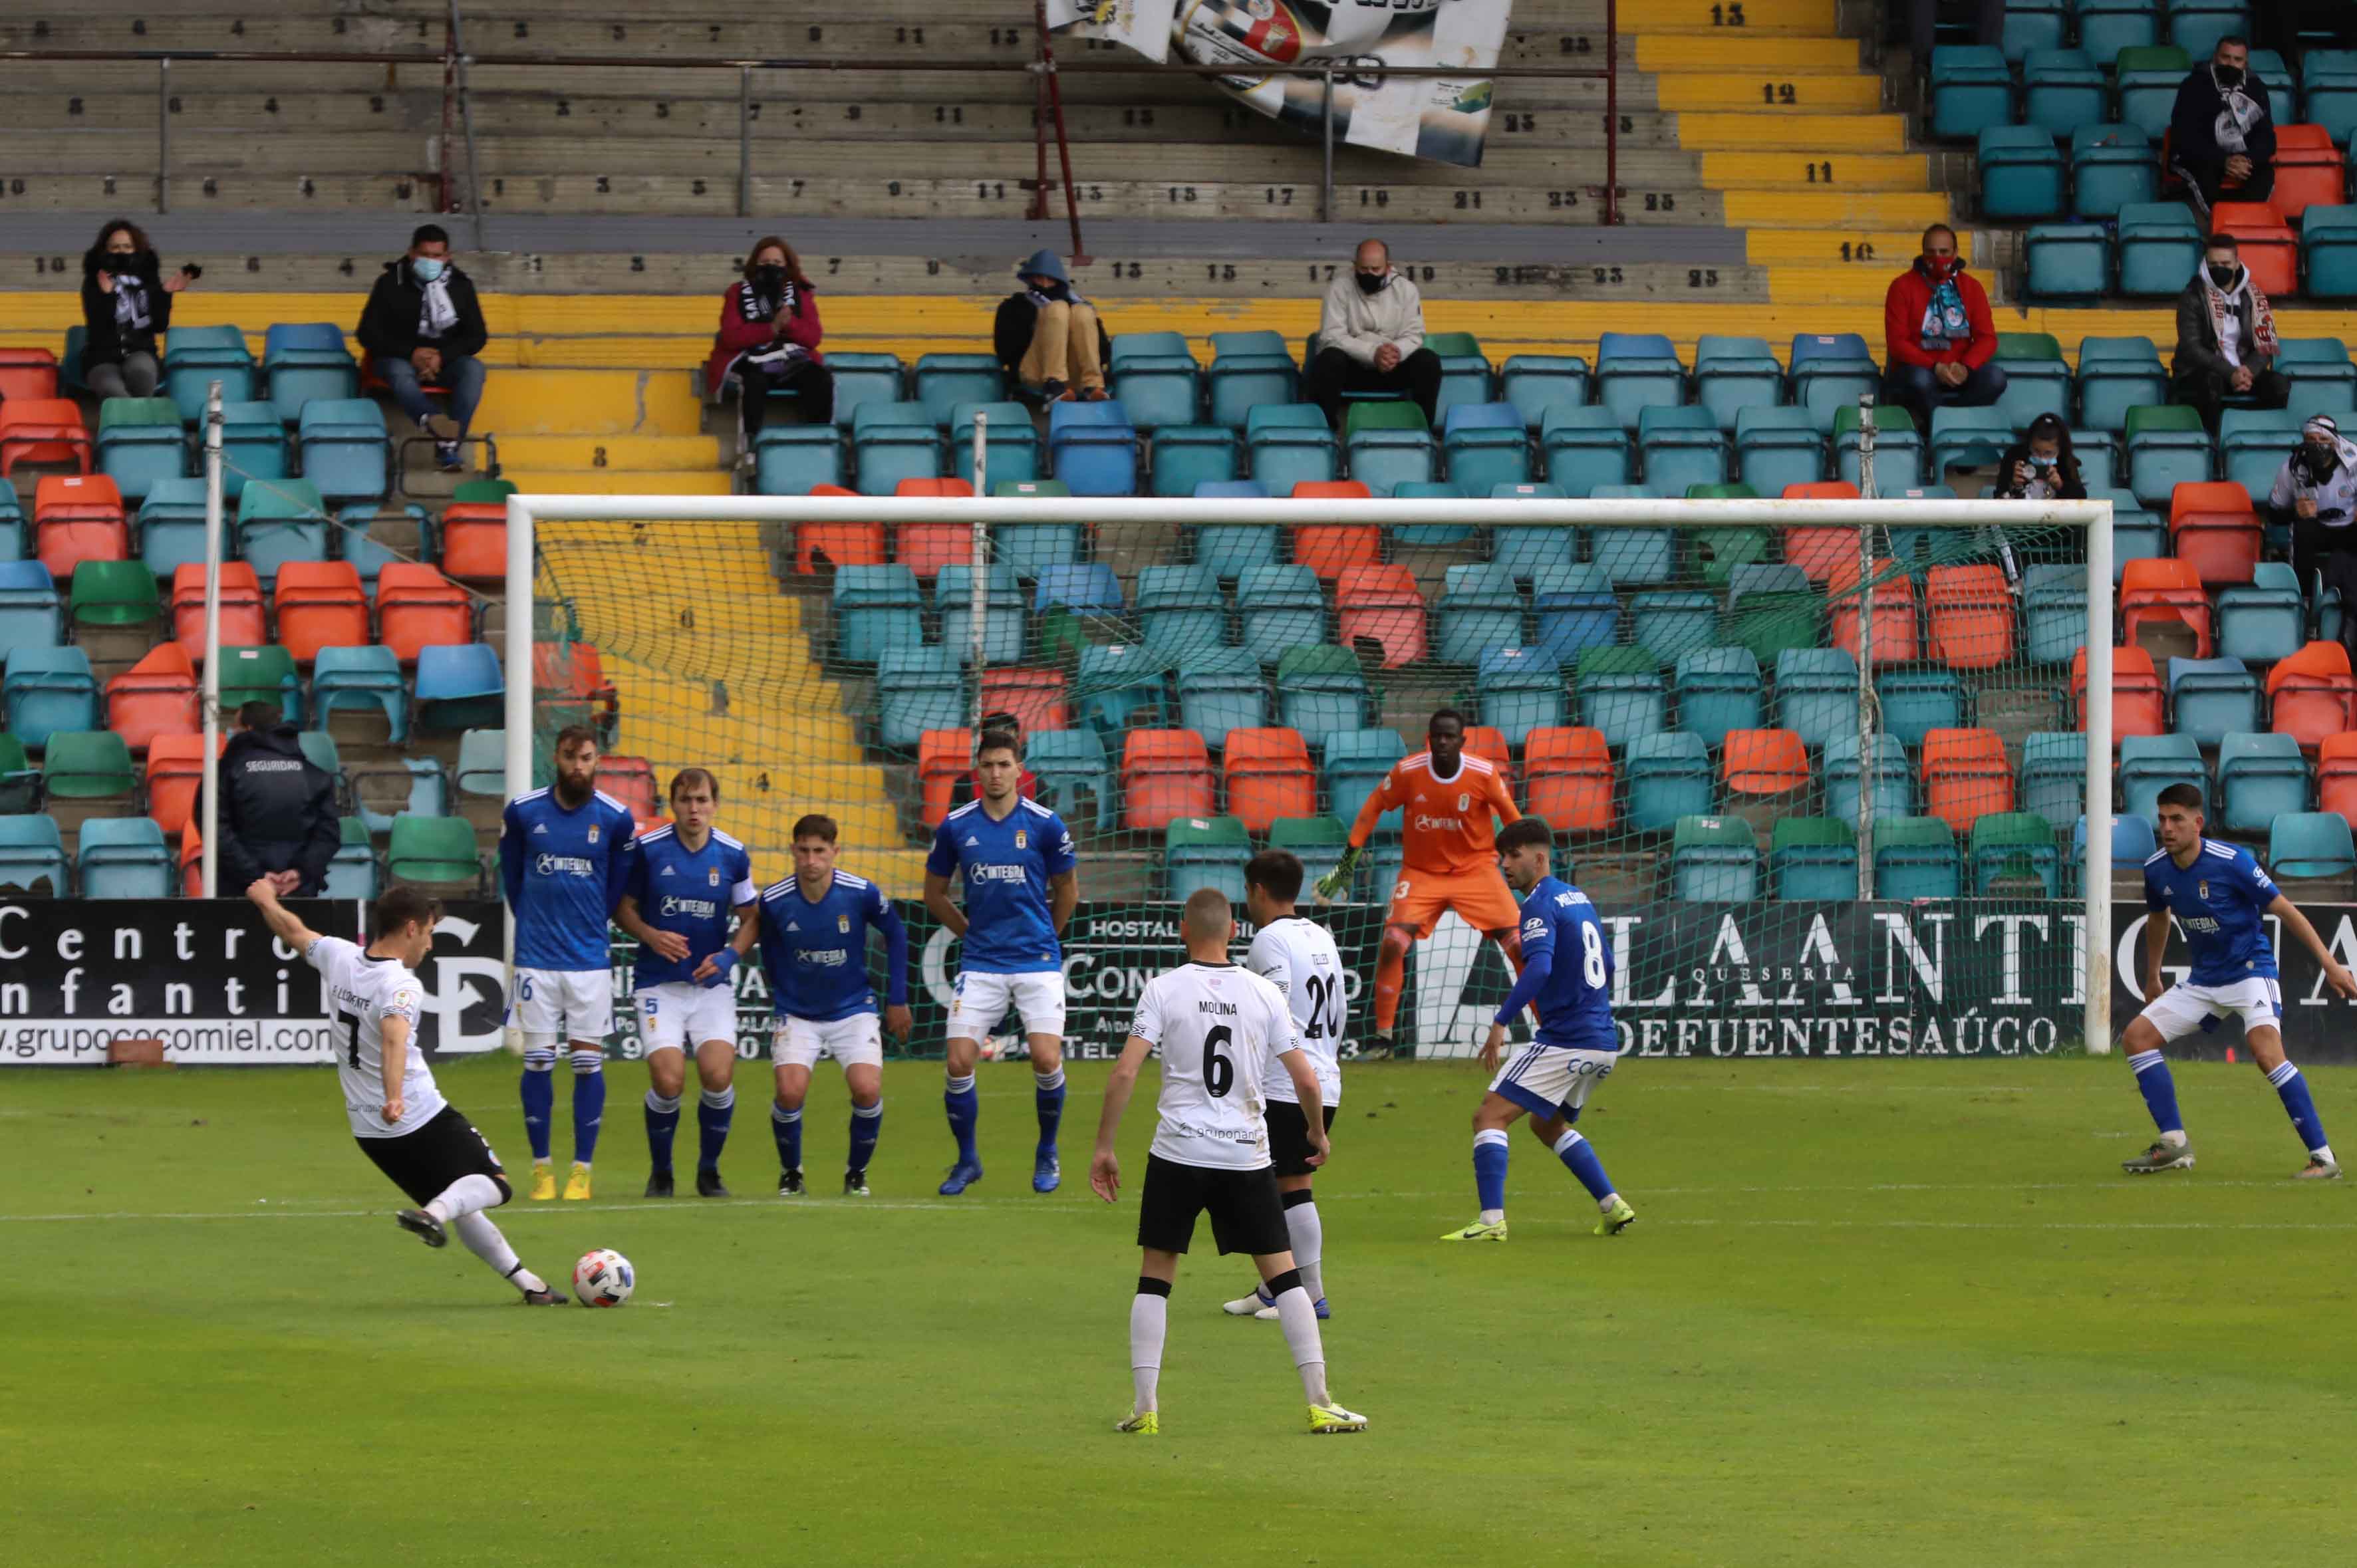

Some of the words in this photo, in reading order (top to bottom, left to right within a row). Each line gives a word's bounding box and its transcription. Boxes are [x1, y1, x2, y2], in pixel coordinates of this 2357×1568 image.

[1711, 4, 1744, 26] 13
[710, 27, 721, 42] 7
[897, 27, 923, 44] 11
[1764, 83, 1796, 104] 12
[1806, 162, 1834, 183] 11
[793, 180, 805, 197] 7
[978, 183, 1004, 199] 11
[1075, 186, 1103, 201] 13
[1169, 186, 1197, 202] 15
[1266, 188, 1293, 205] 17
[1454, 191, 1481, 209] 21
[35, 257, 65, 273] 10
[829, 257, 841, 274] 7
[1308, 265, 1335, 283] 17
[245, 760, 303, 772] SEGURIDAD
[554, 857, 592, 871] INTEGRA
[987, 865, 1025, 878] INTEGRA
[678, 899, 715, 914] INTEGRA
[0, 906, 298, 960] Centro
[1090, 920, 1180, 938] HOSTAL
[1582, 920, 1606, 989] 8
[1693, 965, 1855, 985] QUESERÍA
[646, 999, 658, 1015] 5
[1198, 1001, 1237, 1016] MOLINA
[1305, 972, 1337, 1039] 20
[338, 1009, 361, 1069] 7
[1202, 1025, 1234, 1098] 6
